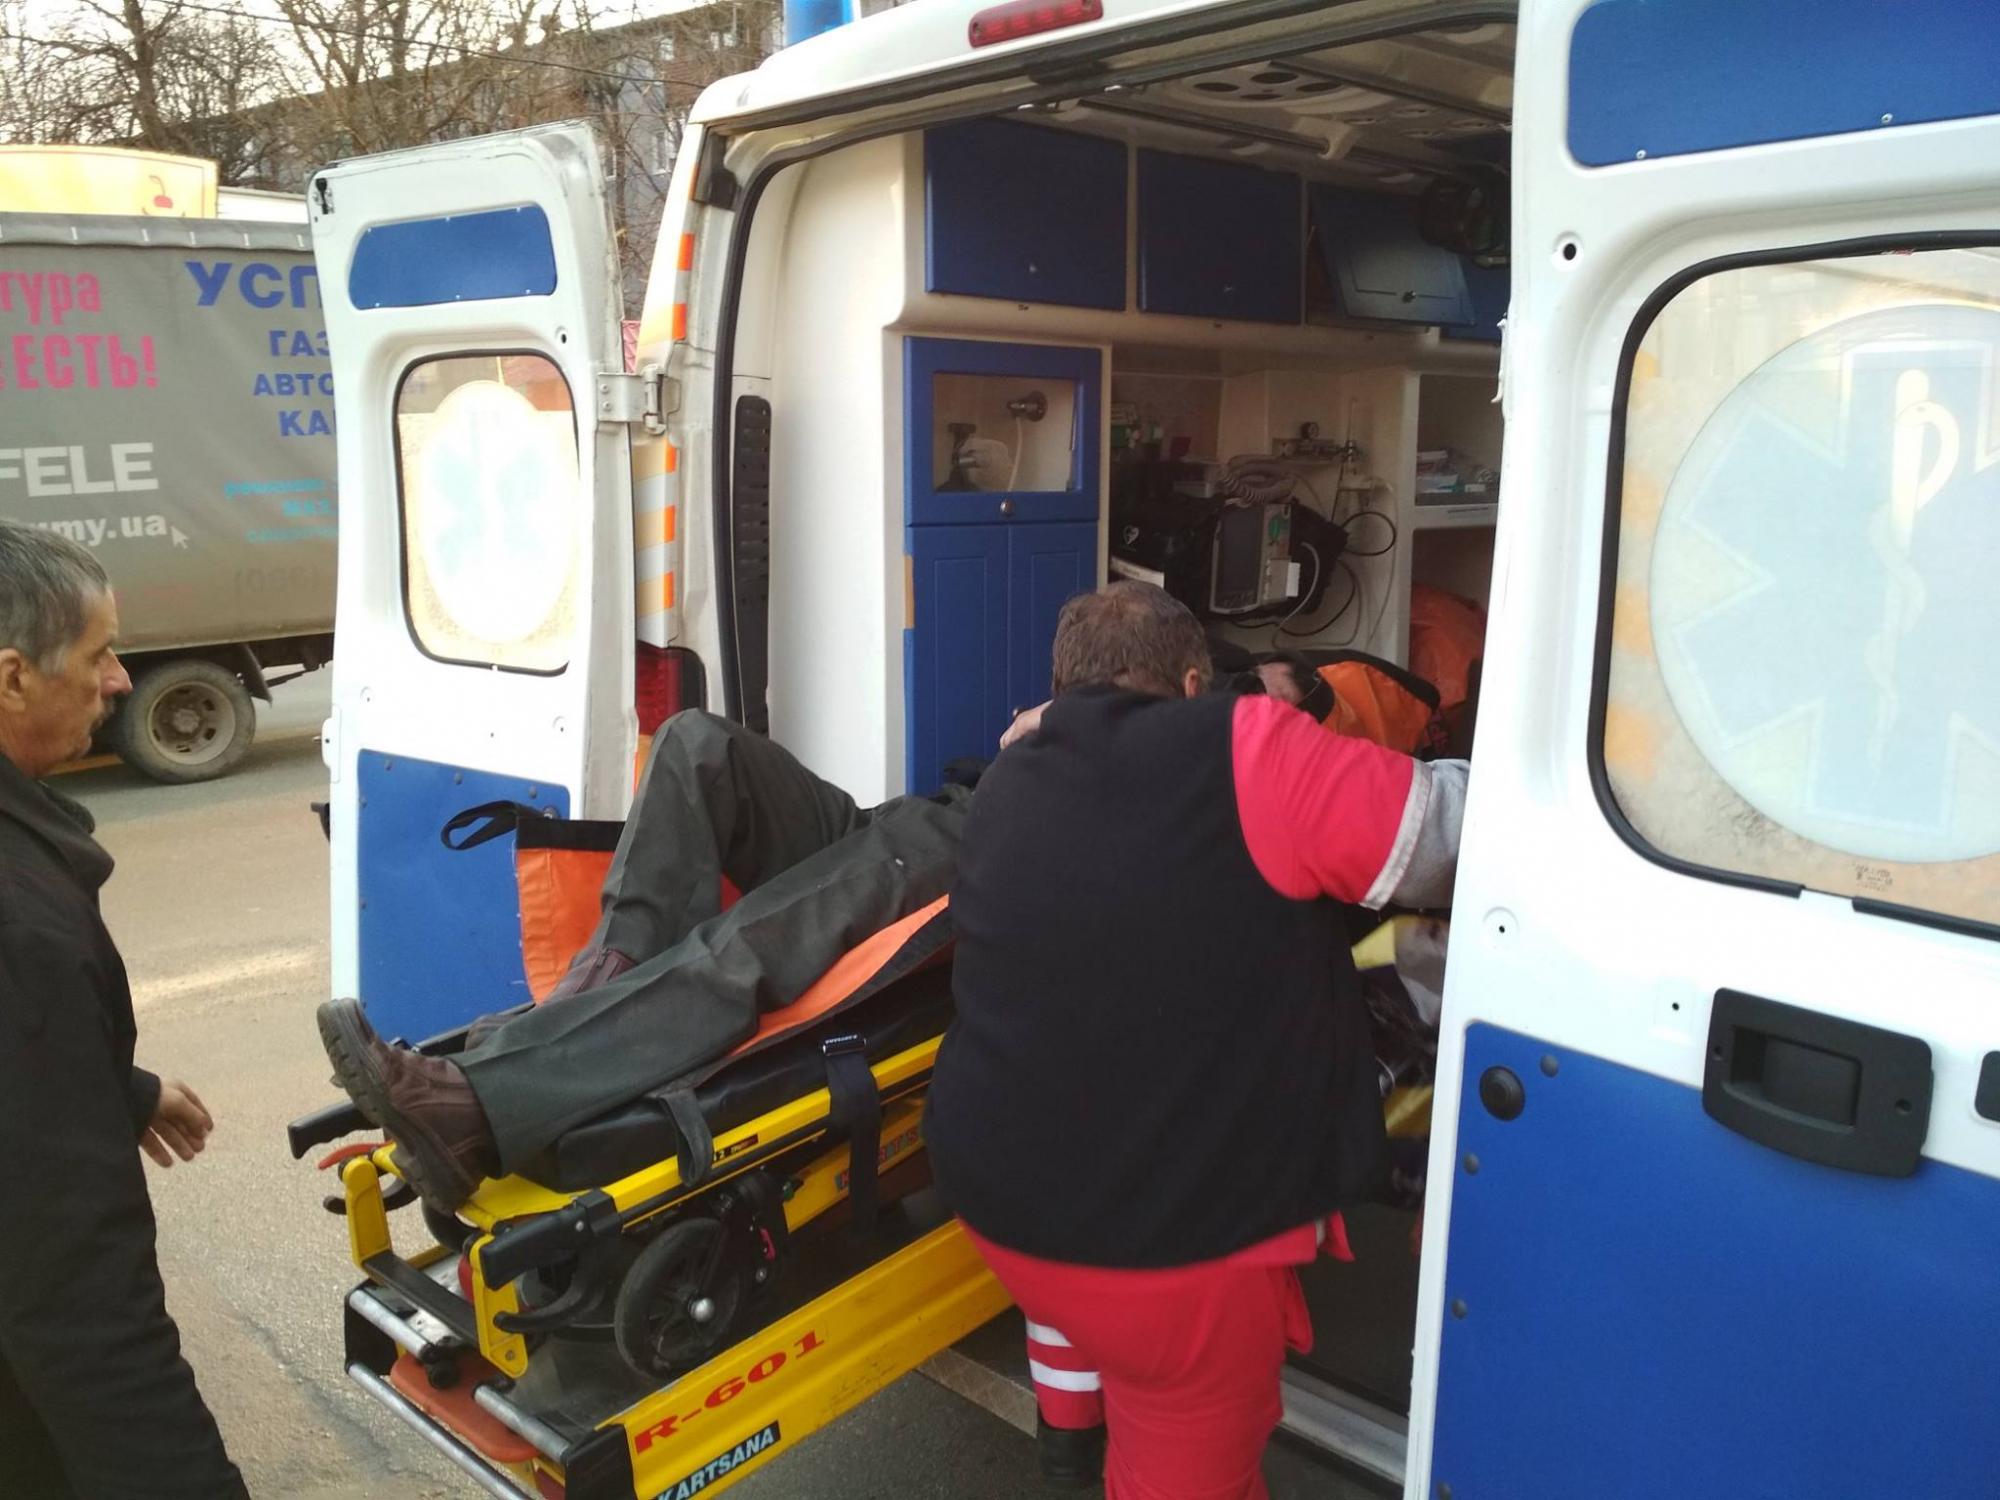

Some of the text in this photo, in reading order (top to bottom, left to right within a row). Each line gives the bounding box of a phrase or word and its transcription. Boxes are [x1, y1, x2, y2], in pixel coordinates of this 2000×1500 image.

[12, 335, 160, 390] ЕСТЬ!
[278, 409, 337, 436] КА
[30, 514, 167, 547] my.ua
[634, 1330, 825, 1456] R-601
